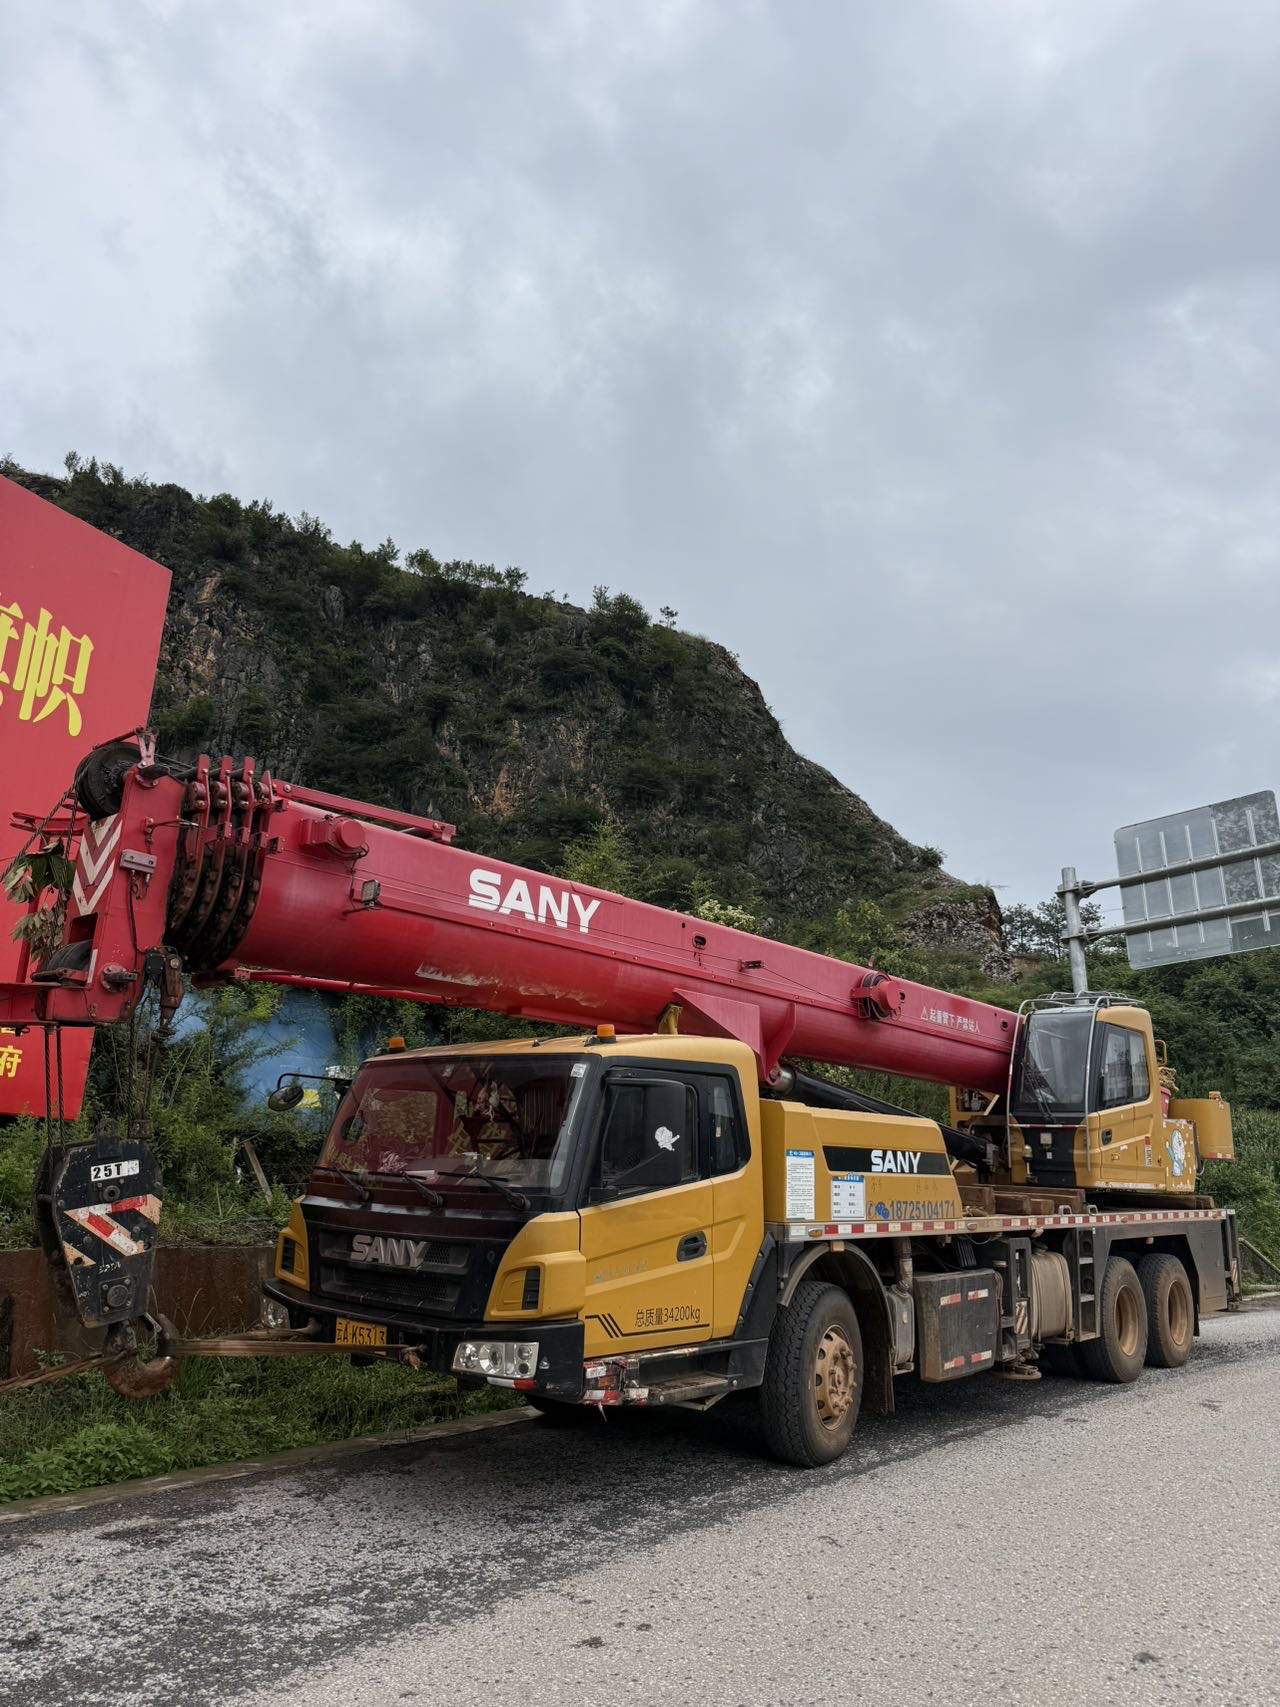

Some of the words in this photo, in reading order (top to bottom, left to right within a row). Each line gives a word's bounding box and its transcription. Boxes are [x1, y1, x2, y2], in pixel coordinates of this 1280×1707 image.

[0, 592, 95, 737] 帜
[468, 868, 601, 934] SANY
[93, 1163, 122, 1179] 25T
[871, 1149, 921, 1173] SANY
[889, 1200, 955, 1220] 18725104171
[350, 1234, 431, 1268] SANY
[634, 1304, 701, 1328] 总质量34200kg
